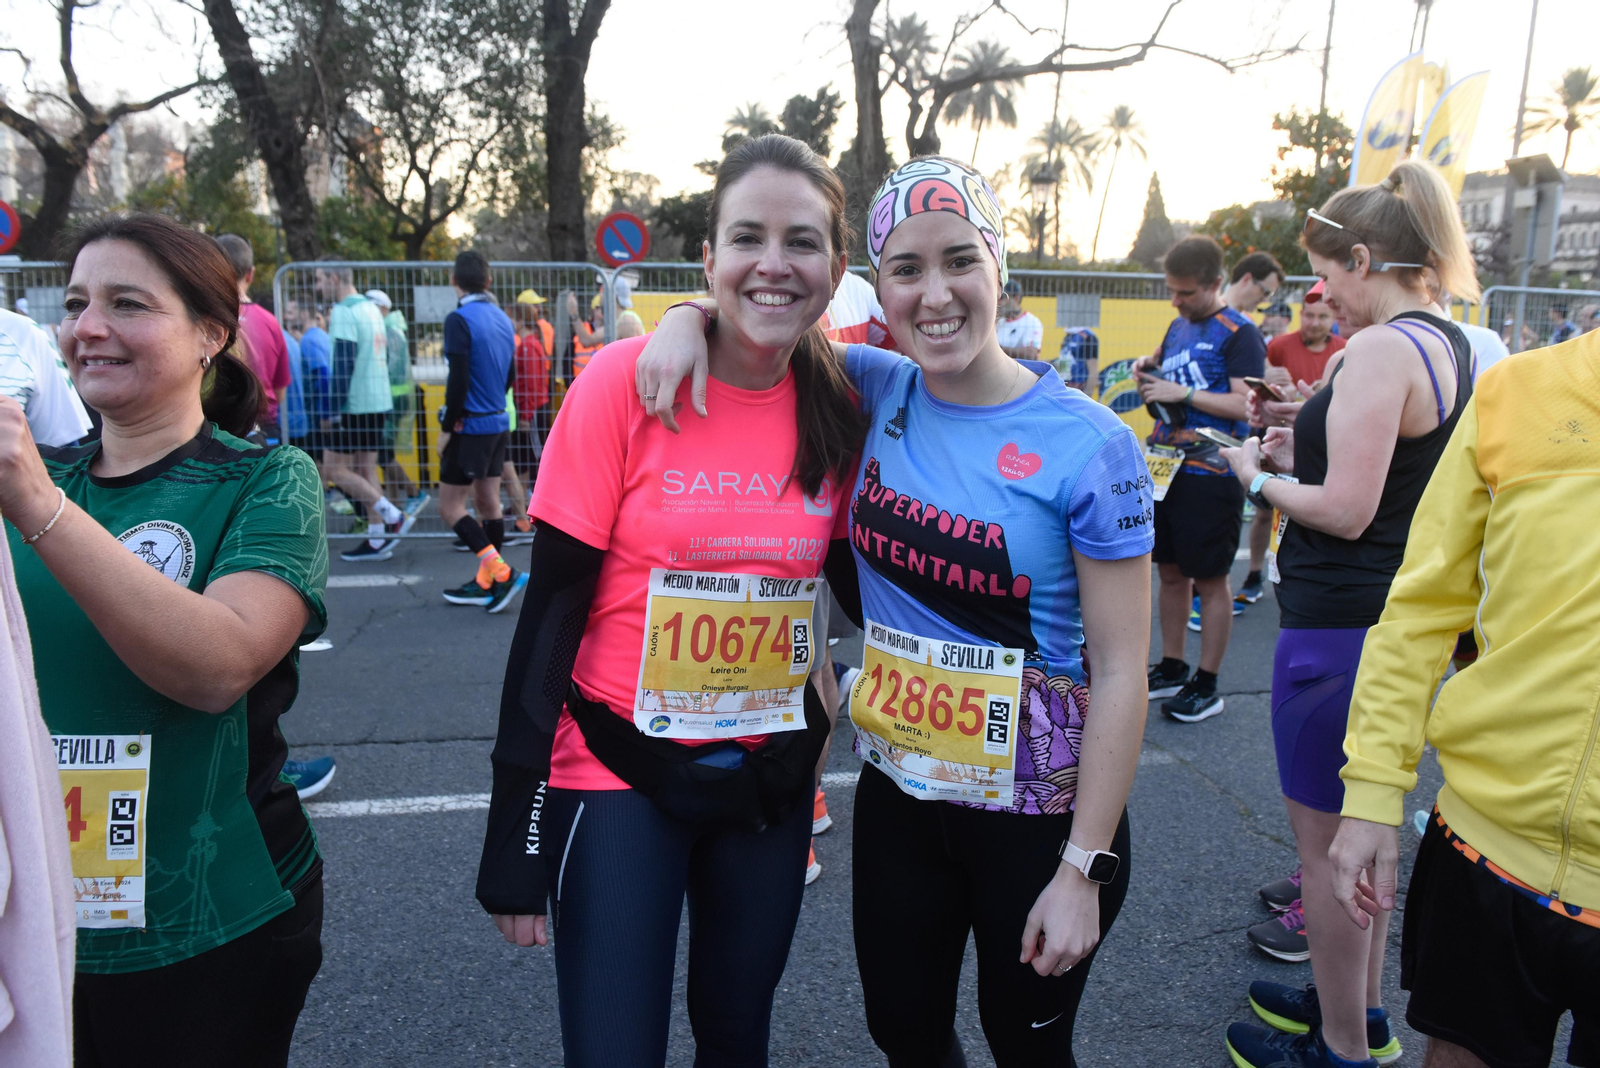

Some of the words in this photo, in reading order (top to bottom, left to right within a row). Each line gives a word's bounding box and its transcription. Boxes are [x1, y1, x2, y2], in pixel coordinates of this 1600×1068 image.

[866, 456, 880, 475] EL
[661, 470, 788, 496] SARAY
[662, 498, 699, 506] Asociación
[671, 505, 696, 513] Cáncer
[858, 477, 1003, 549] SUPERPODER
[147, 521, 175, 533] DIVINA
[685, 550, 736, 561] LASTERKETA
[707, 536, 742, 548] CARRERA
[744, 535, 783, 548] SOLIDARIA
[786, 537, 824, 561] 2022
[663, 573, 693, 589] MEDIO
[695, 575, 740, 594] MARATÓN
[759, 577, 802, 598] SEVILLA
[650, 632, 659, 657] CAJÓN
[663, 612, 792, 664] 10674
[870, 624, 887, 644] MEDIO
[887, 635, 919, 655] MARATÓN
[940, 643, 994, 670] SEVILLA
[710, 666, 731, 674] Leire
[733, 666, 747, 674] Oni
[726, 684, 750, 692] Iturgaiz
[854, 677, 867, 699] CAJÓN
[866, 663, 985, 736] 12865
[714, 718, 738, 729] HOKA
[894, 722, 923, 737] MARTA
[891, 740, 913, 751] Santos
[914, 746, 932, 756] Royo
[903, 777, 927, 791] HOKA
[526, 780, 548, 855] KIPRUN
